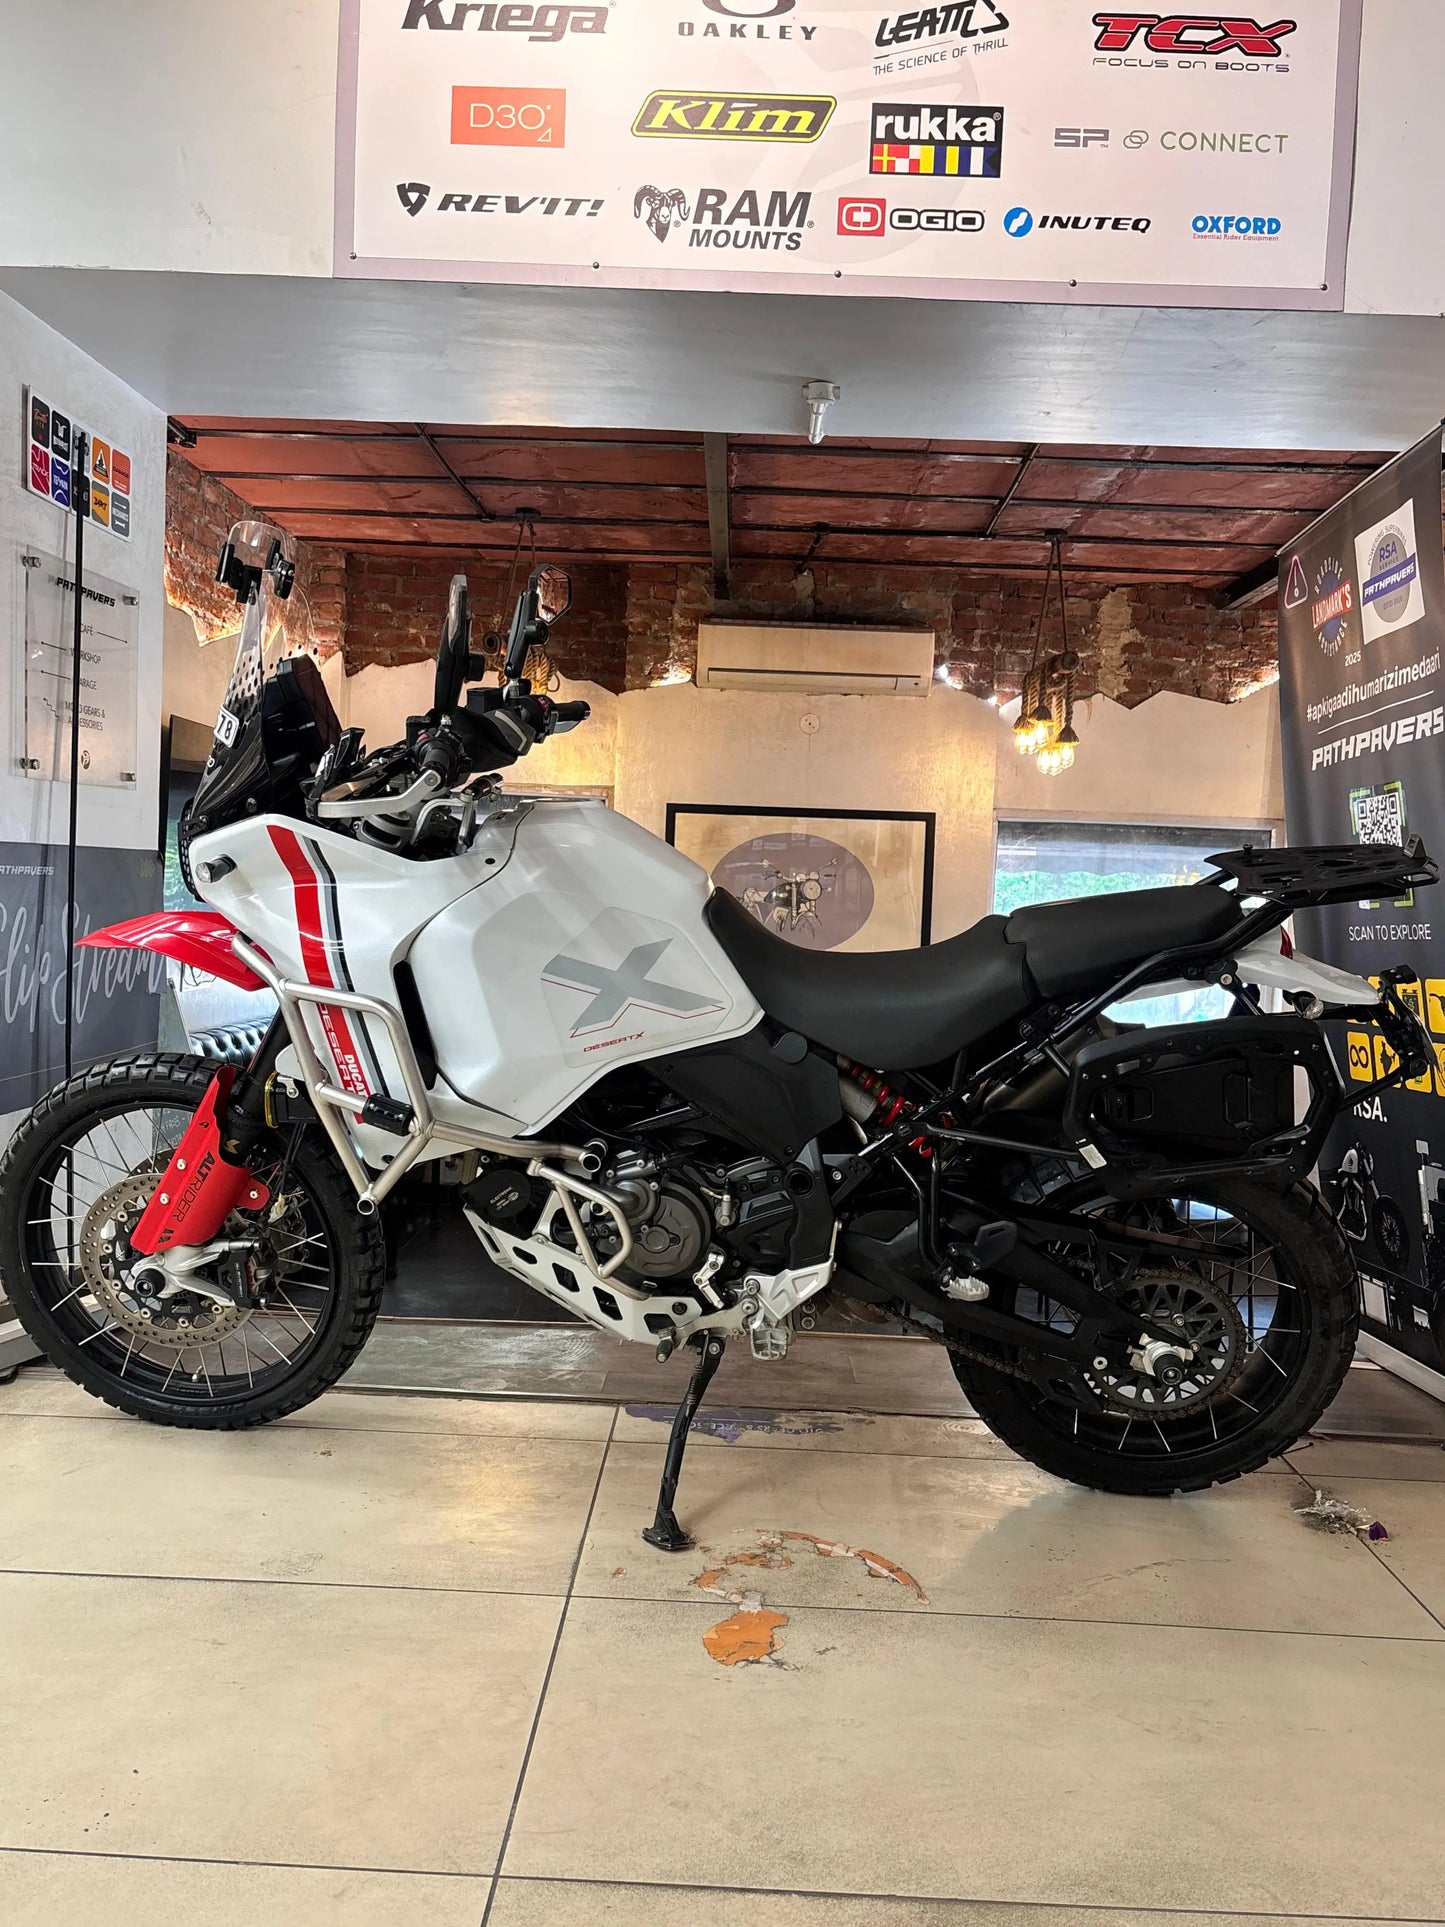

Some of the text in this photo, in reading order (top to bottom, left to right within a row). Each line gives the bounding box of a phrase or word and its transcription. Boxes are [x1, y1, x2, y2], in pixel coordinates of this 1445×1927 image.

[401, 0, 608, 42] Kriega
[678, 21, 818, 41] OAKLEY
[1092, 12, 1297, 58] TCX
[873, 38, 1008, 76] THE SCIENCE OF THRILL
[1093, 58, 1169, 68] FOCUS
[1215, 62, 1290, 72] BOOTS
[875, 107, 997, 142] rukka
[1054, 128, 1289, 154] SP CONNECT
[437, 194, 605, 218] REV'IT!
[691, 188, 813, 229] RAM
[890, 207, 985, 232] OGIO
[1038, 214, 1152, 235] INUTEQ
[1191, 215, 1281, 235] OXFORD
[688, 229, 803, 251] MOUNTS
[1242, 234, 1279, 242] Equipment
[1379, 541, 1398, 563] RSA
[56, 576, 116, 608] PATPAVERS
[1364, 562, 1415, 599] PATHPAVERS
[1311, 583, 1352, 629] LANDMARK'S
[69, 647, 101, 664] WRKSHOP
[1344, 650, 1362, 667] 2025
[67, 716, 103, 731] AESSORIES
[1311, 706, 1445, 772] PATHPAVERS
[0, 865, 54, 876] ATHPAVERS
[1348, 923, 1432, 941] SCAN TO EXPLORE
[583, 1031, 645, 1053] DESERTX
[344, 1053, 368, 1097] DUCAT
[172, 1151, 216, 1223] ALTRIDER
